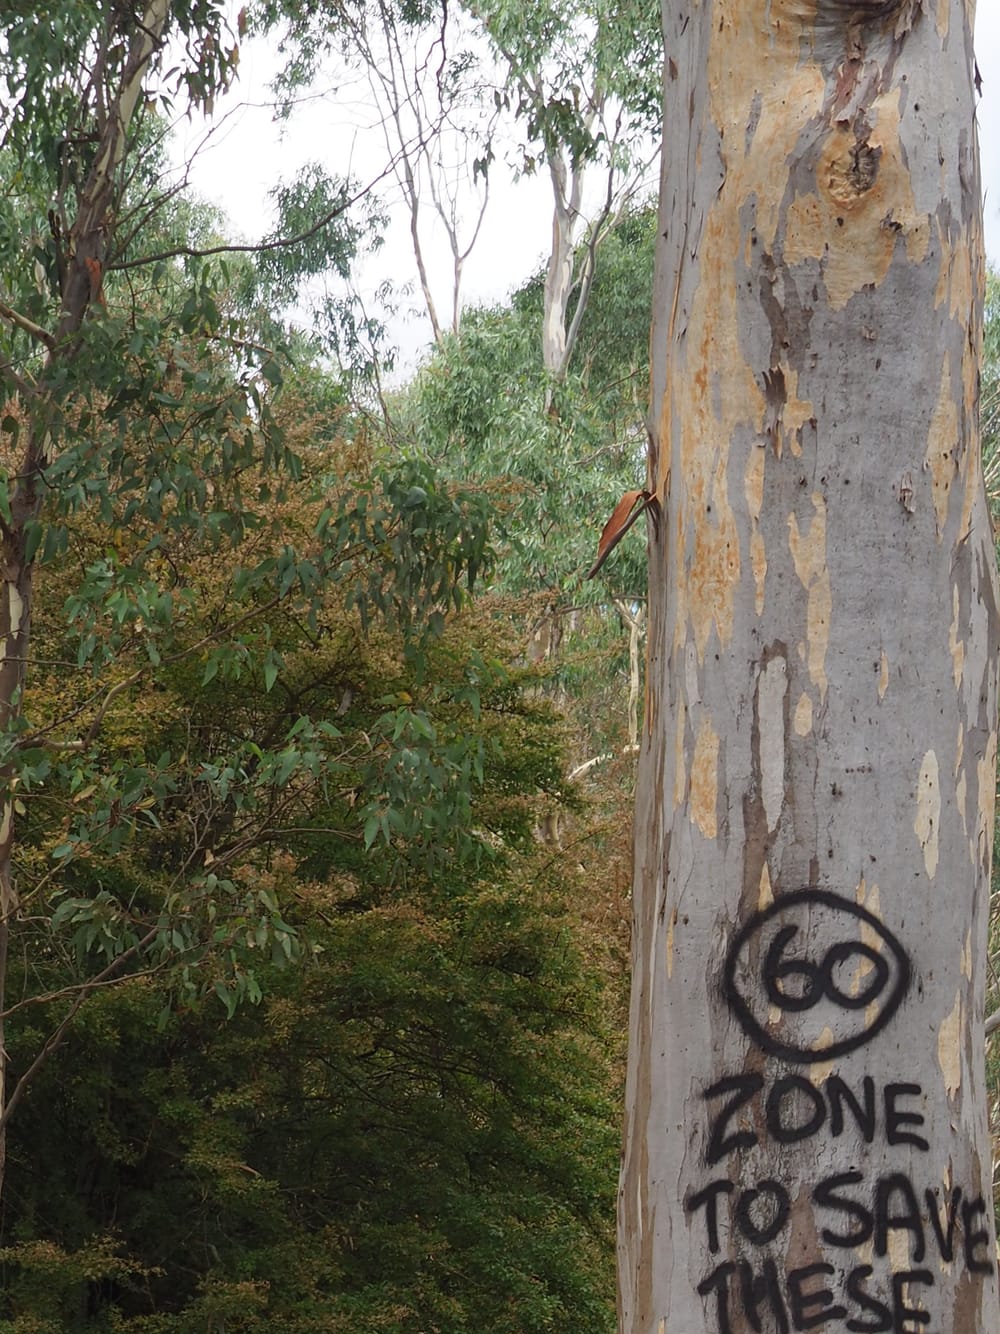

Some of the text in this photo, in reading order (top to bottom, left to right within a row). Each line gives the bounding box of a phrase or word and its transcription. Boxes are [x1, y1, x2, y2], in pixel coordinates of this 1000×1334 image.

[763, 923, 890, 1013] 60
[702, 1072, 930, 1165] ZONE
[686, 1171, 994, 1275] TO SAVE
